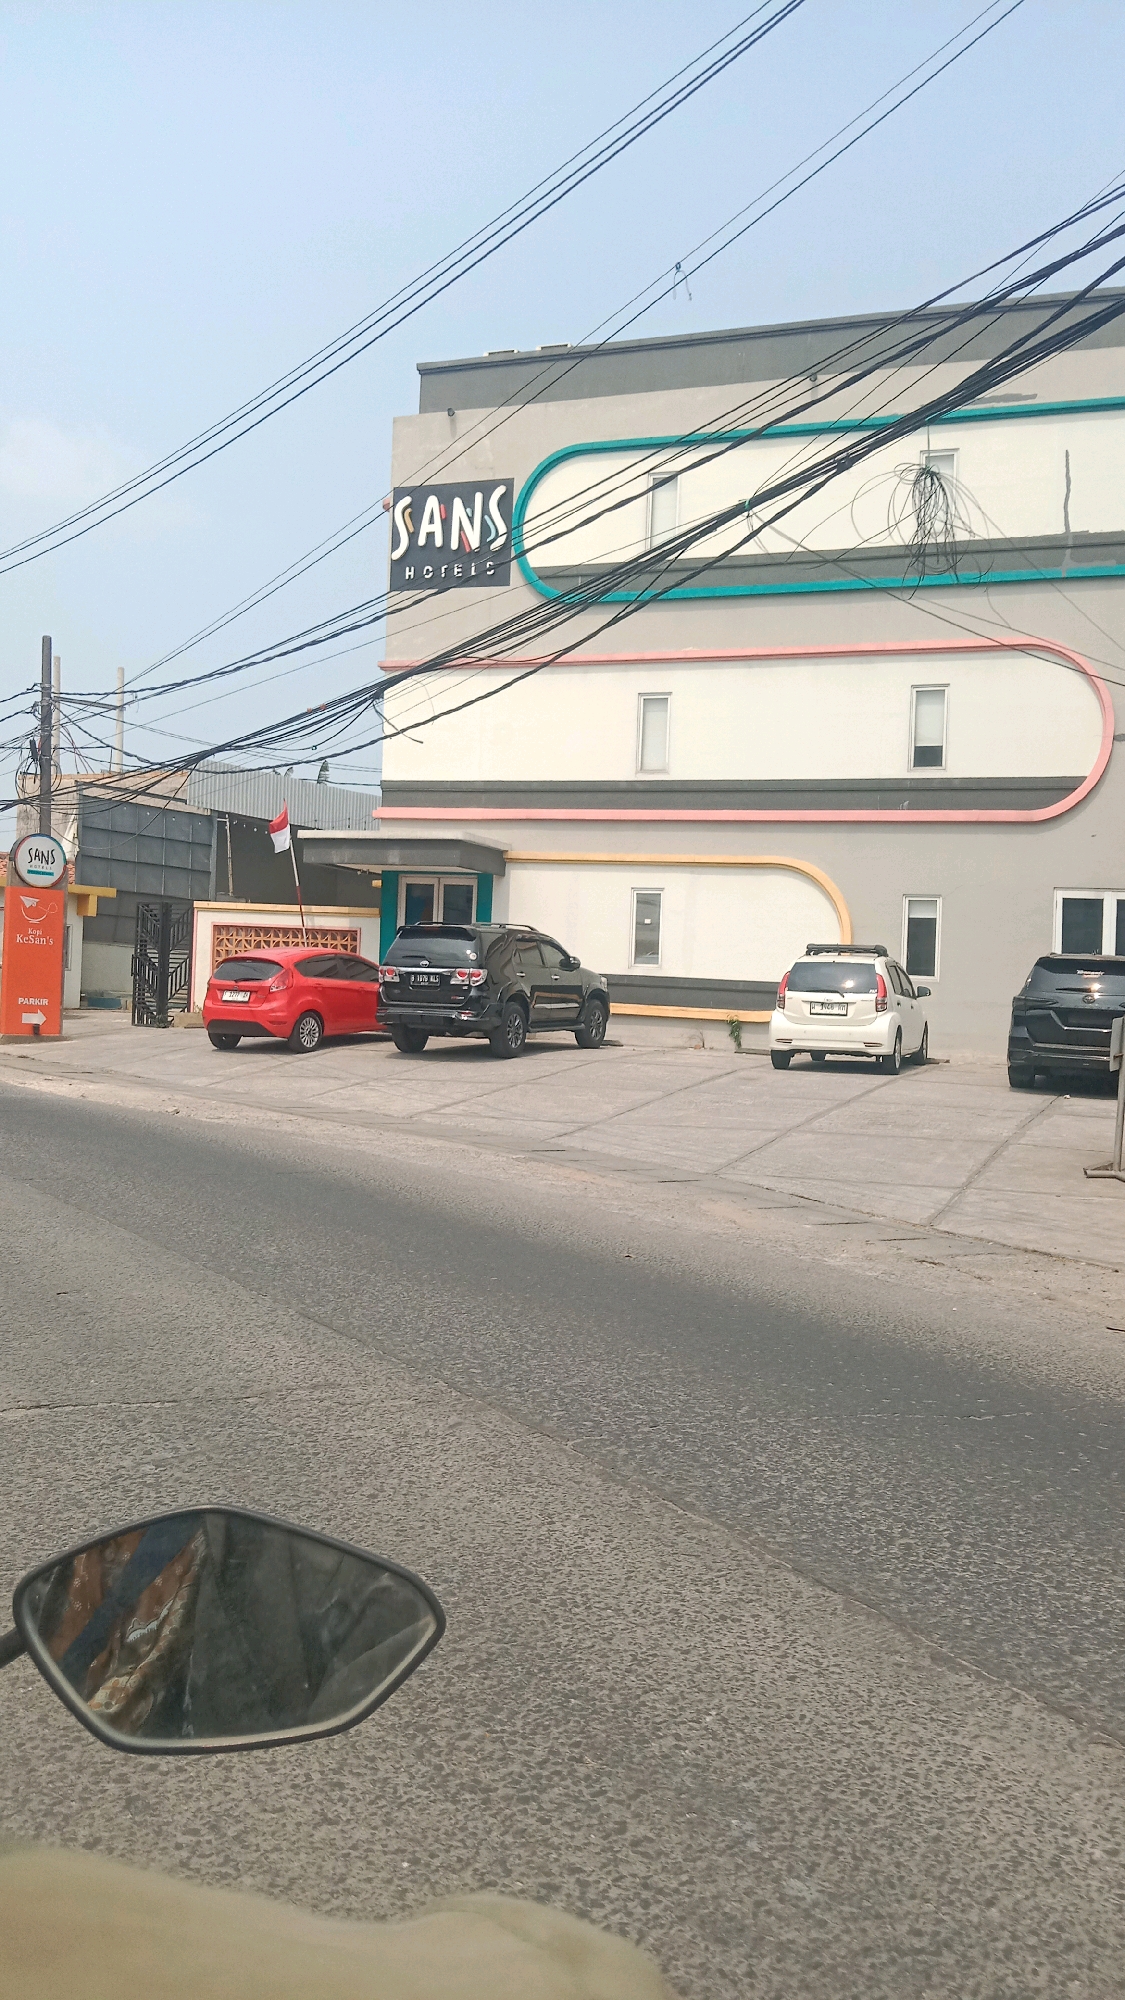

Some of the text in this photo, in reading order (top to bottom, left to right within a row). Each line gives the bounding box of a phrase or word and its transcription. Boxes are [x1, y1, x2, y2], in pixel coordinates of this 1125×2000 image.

[391, 485, 507, 560] SANS
[27, 847, 56, 865] SANS
[28, 927, 42, 935] Kopi
[16, 933, 54, 945] KeSan's
[18, 997, 49, 1006] PARKIR
